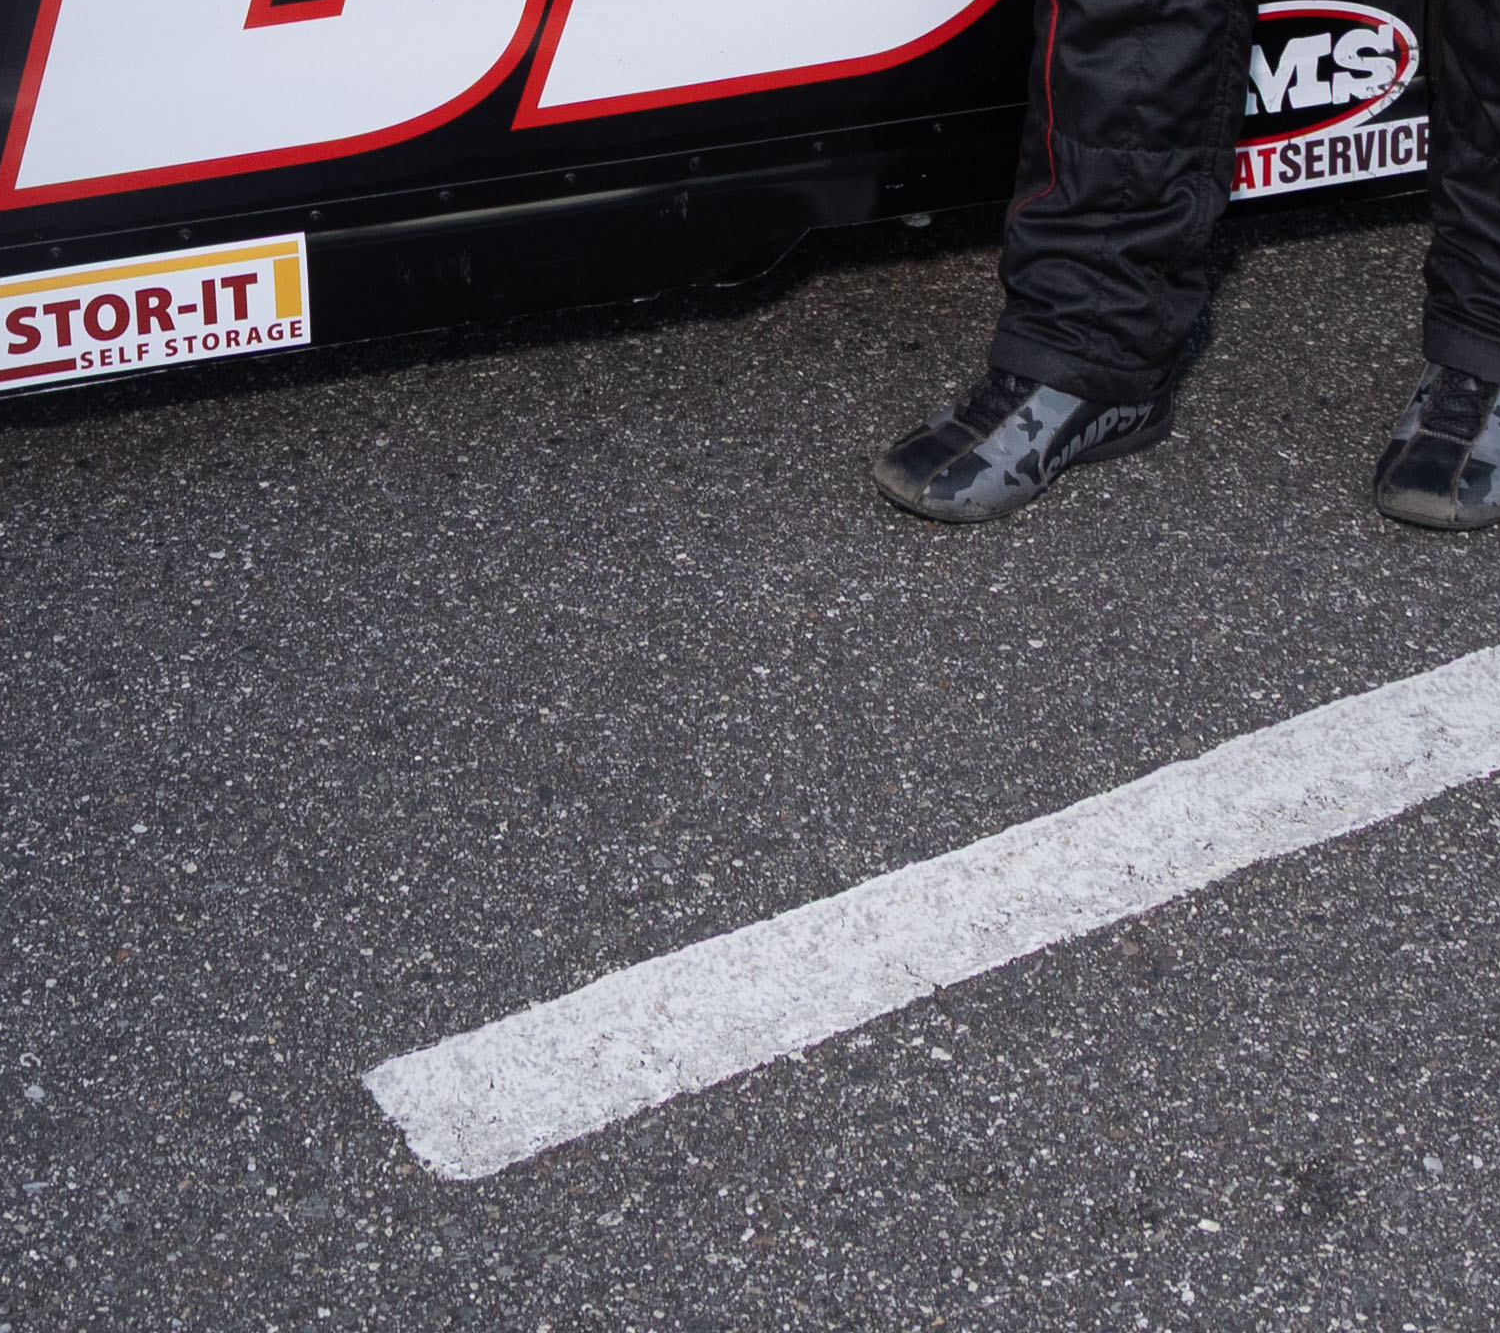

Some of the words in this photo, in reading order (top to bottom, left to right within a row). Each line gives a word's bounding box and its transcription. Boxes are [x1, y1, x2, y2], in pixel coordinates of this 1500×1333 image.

[1246, 25, 1396, 114] MS
[4, 273, 263, 356] STOR-IT
[77, 340, 154, 371] SELF
[165, 316, 304, 361] STORAGE
